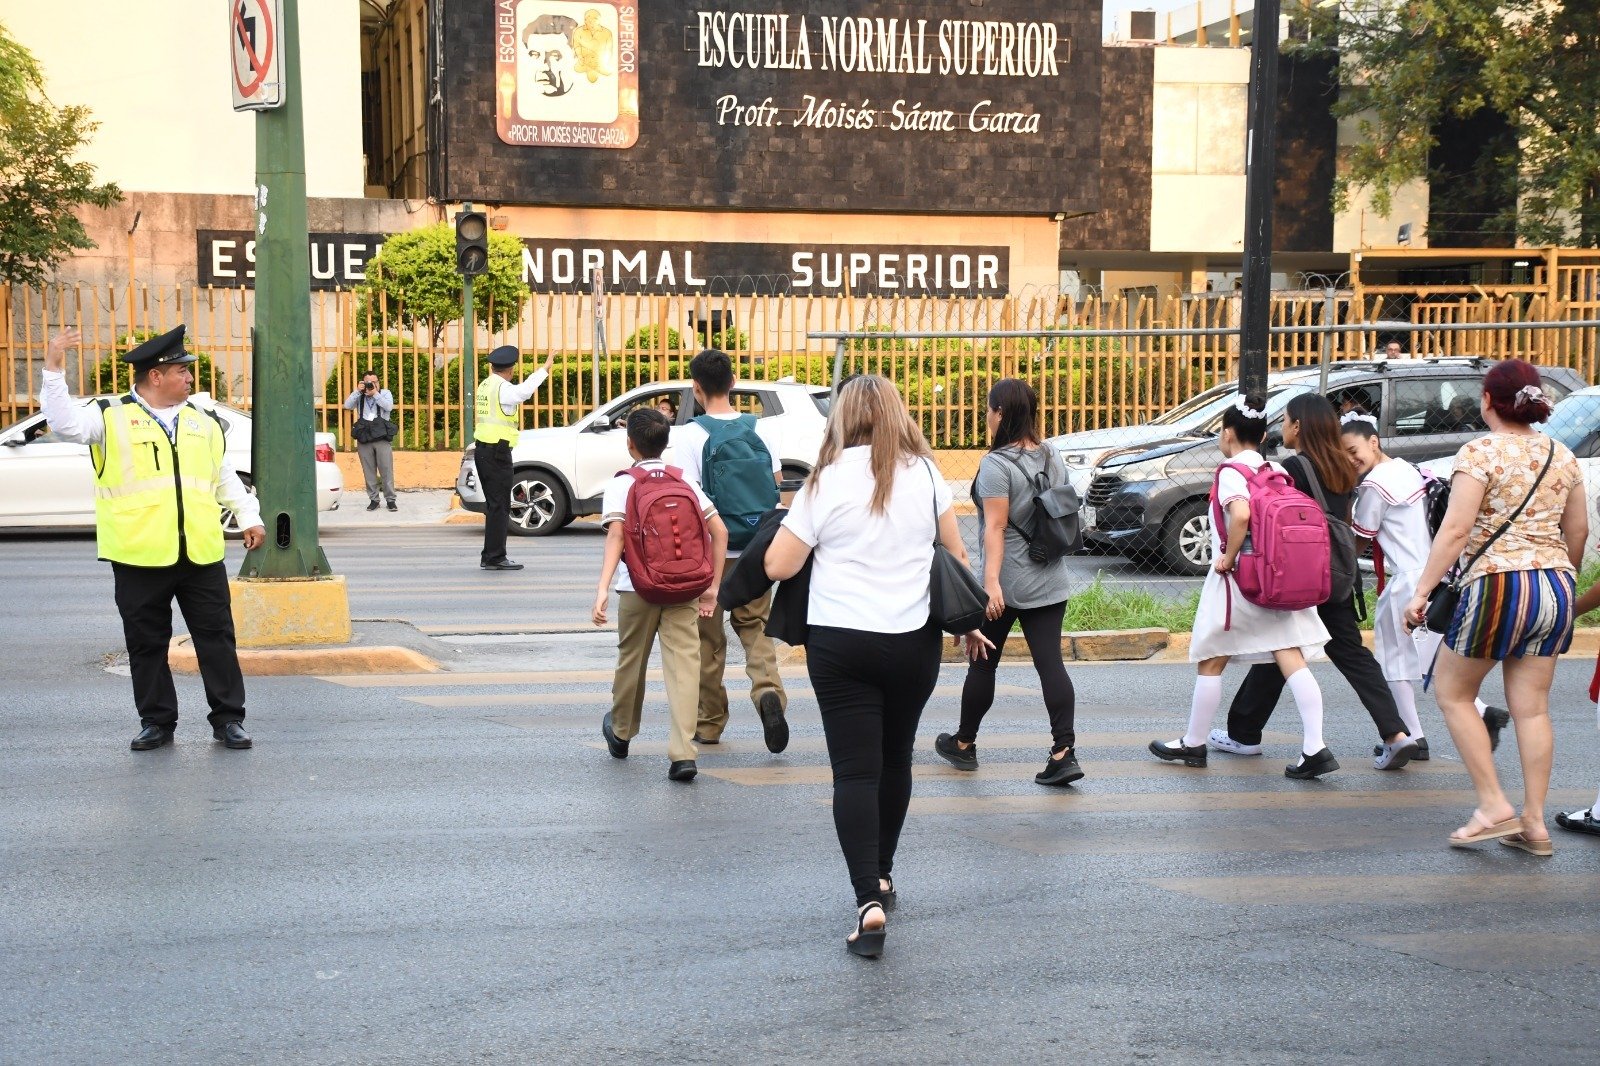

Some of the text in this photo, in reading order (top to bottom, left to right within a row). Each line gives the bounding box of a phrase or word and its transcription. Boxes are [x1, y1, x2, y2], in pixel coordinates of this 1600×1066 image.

[499, 0, 515, 63] ESCUELA
[620, 6, 635, 73] SUPERIOR
[697, 10, 1060, 78] ESCUELA NORMAL SUPERIOR
[715, 94, 1042, 134] Profr. Moisés Sáenz Garza
[521, 247, 999, 289] NORMAL SUPERIOR
